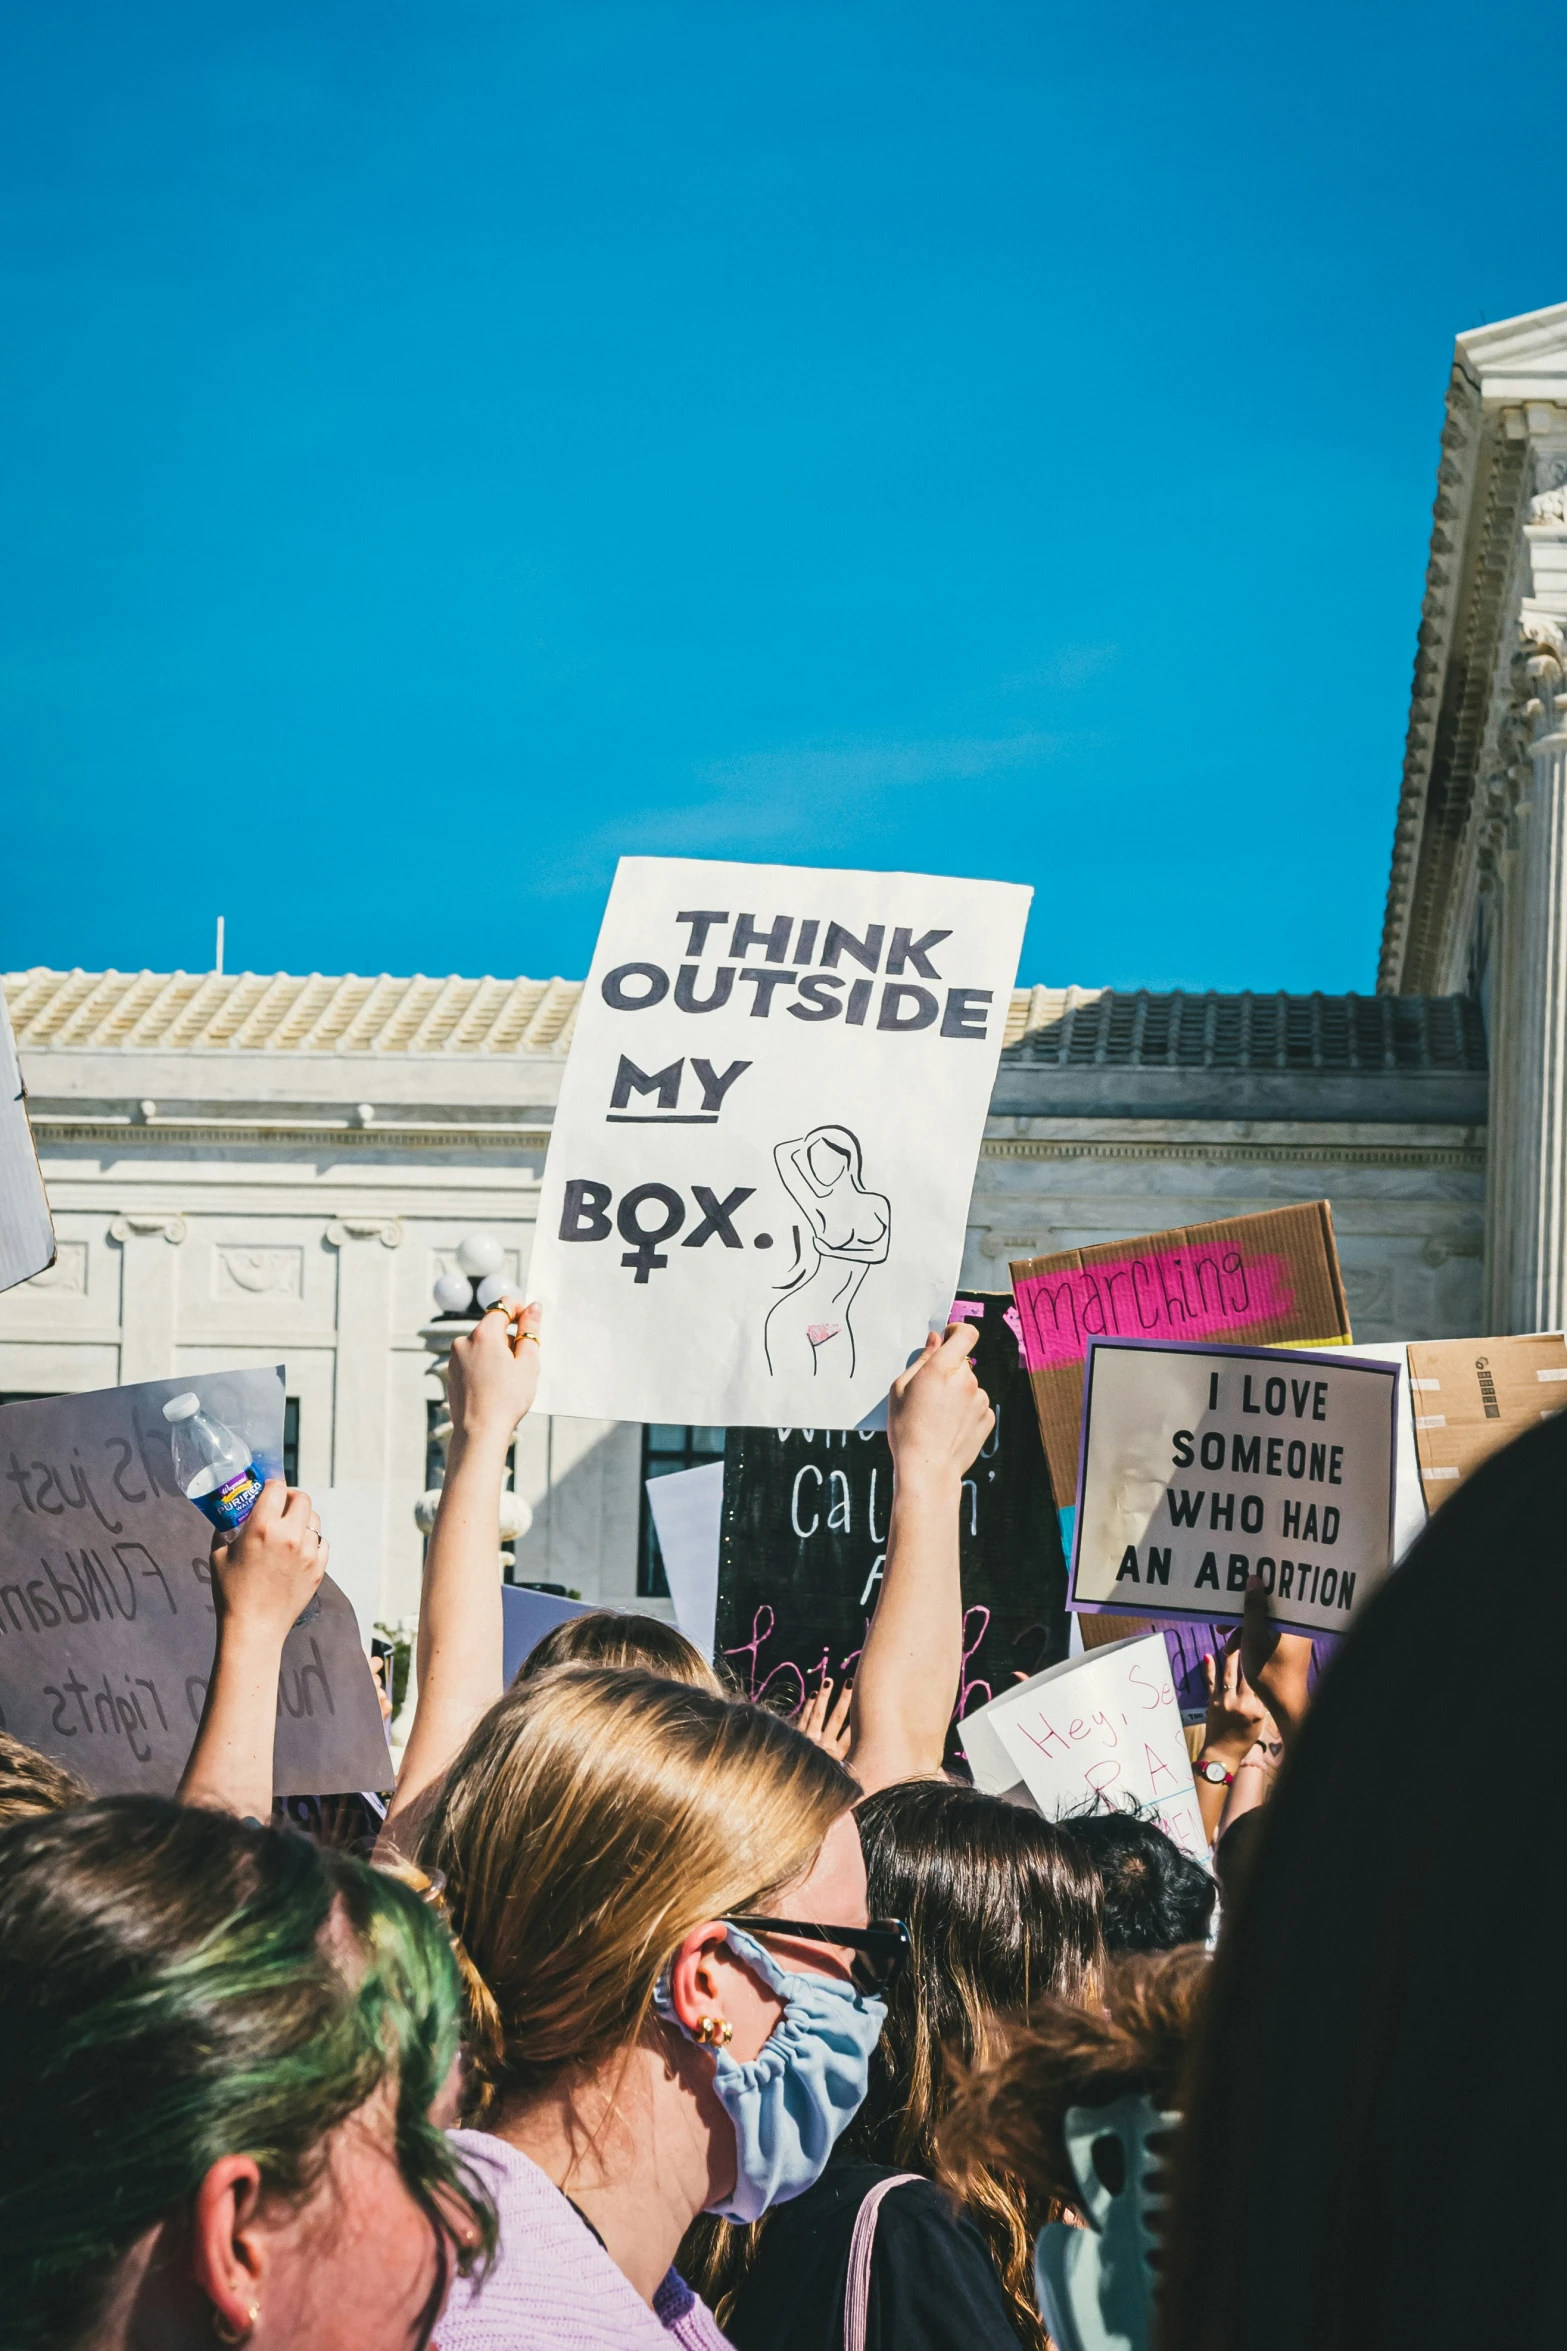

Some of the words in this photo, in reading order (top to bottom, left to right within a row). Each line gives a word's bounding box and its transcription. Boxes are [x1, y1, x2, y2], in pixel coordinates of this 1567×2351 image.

[676, 910, 953, 980] THINK
[601, 962, 994, 1040] OUTSIDE
[609, 1053, 754, 1112] MY
[558, 1179, 774, 1284] BOX.
[1026, 1251, 1251, 1355] marching
[1208, 1371, 1219, 1411] I
[1242, 1374, 1329, 1422] LOVE
[1171, 1429, 1345, 1485] SOMEONE
[216, 1481, 262, 1515] PURIFIED
[1166, 1488, 1264, 1534] WHO
[1282, 1501, 1341, 1546] HAD
[1115, 1545, 1172, 1586] AN
[1194, 1550, 1357, 1611] ABORTION
[1017, 1709, 1129, 1759] Hey,
